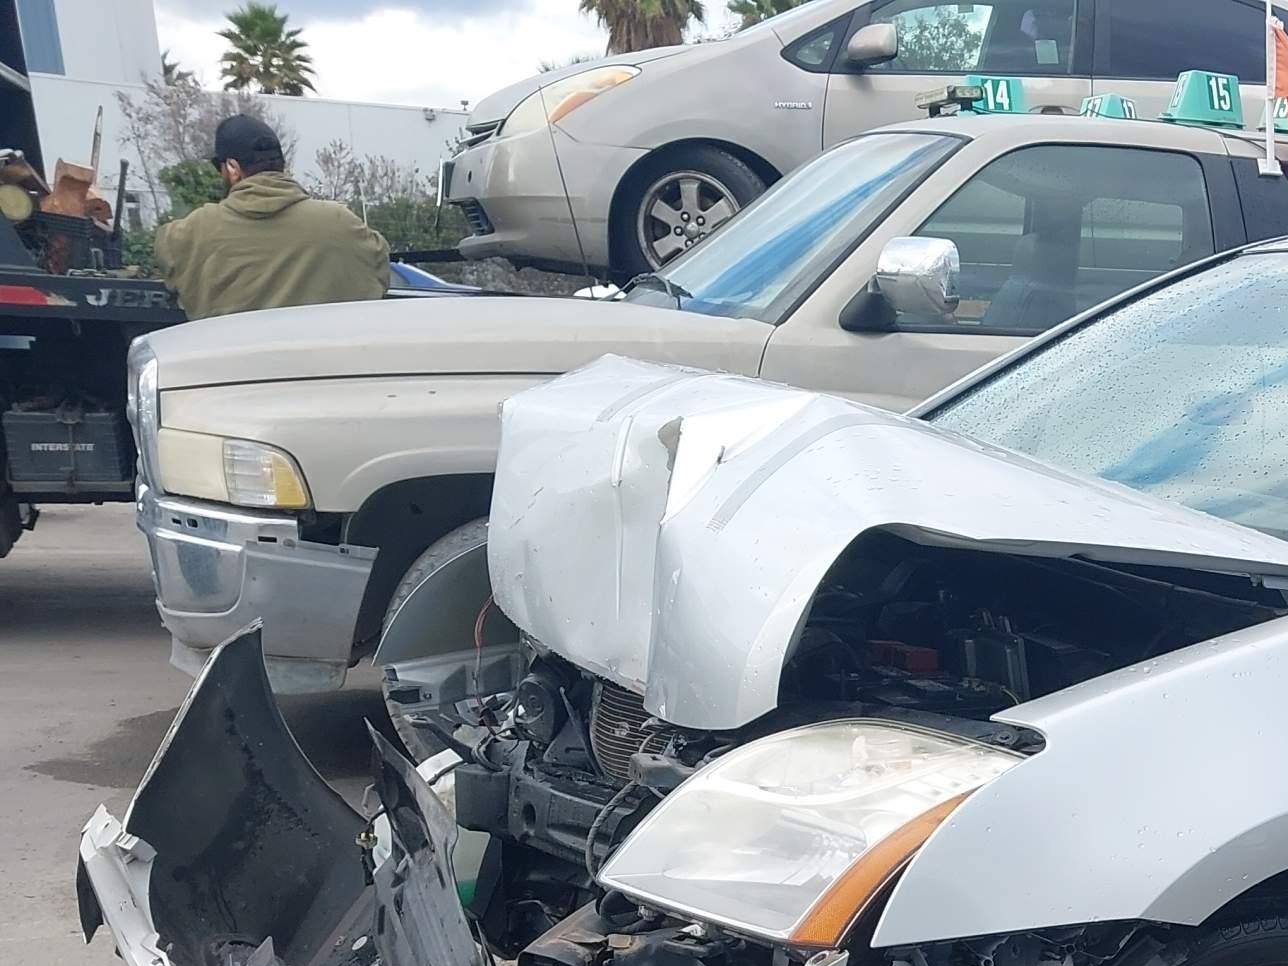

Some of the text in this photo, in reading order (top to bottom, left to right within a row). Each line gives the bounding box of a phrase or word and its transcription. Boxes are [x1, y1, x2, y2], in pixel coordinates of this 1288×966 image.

[984, 80, 1010, 111] 14
[1210, 77, 1231, 110] 15
[31, 443, 97, 451] INTERSATE
